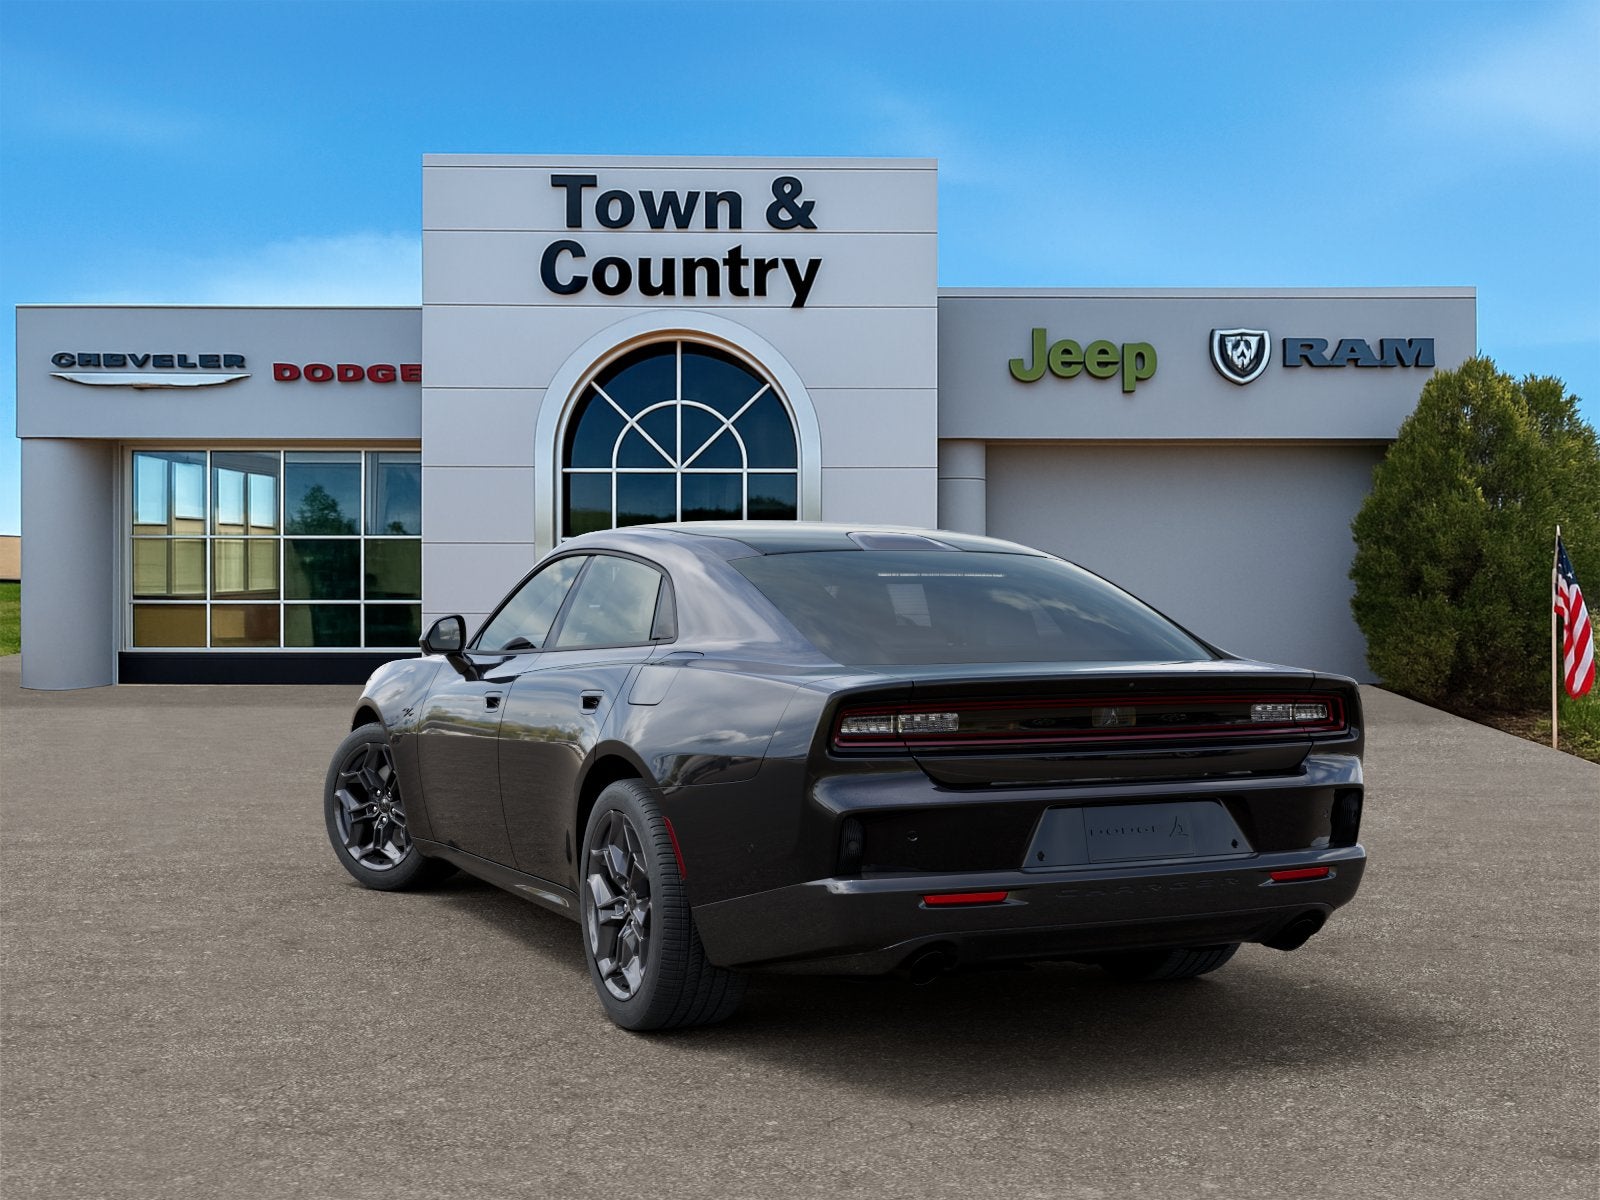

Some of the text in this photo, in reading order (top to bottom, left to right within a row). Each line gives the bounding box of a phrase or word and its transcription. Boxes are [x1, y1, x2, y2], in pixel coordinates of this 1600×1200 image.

[551, 174, 818, 230] Town &
[540, 240, 822, 308] Country
[273, 363, 421, 383] DODGE
[1009, 328, 1158, 393] Jeep
[1283, 338, 1435, 367] RAM
